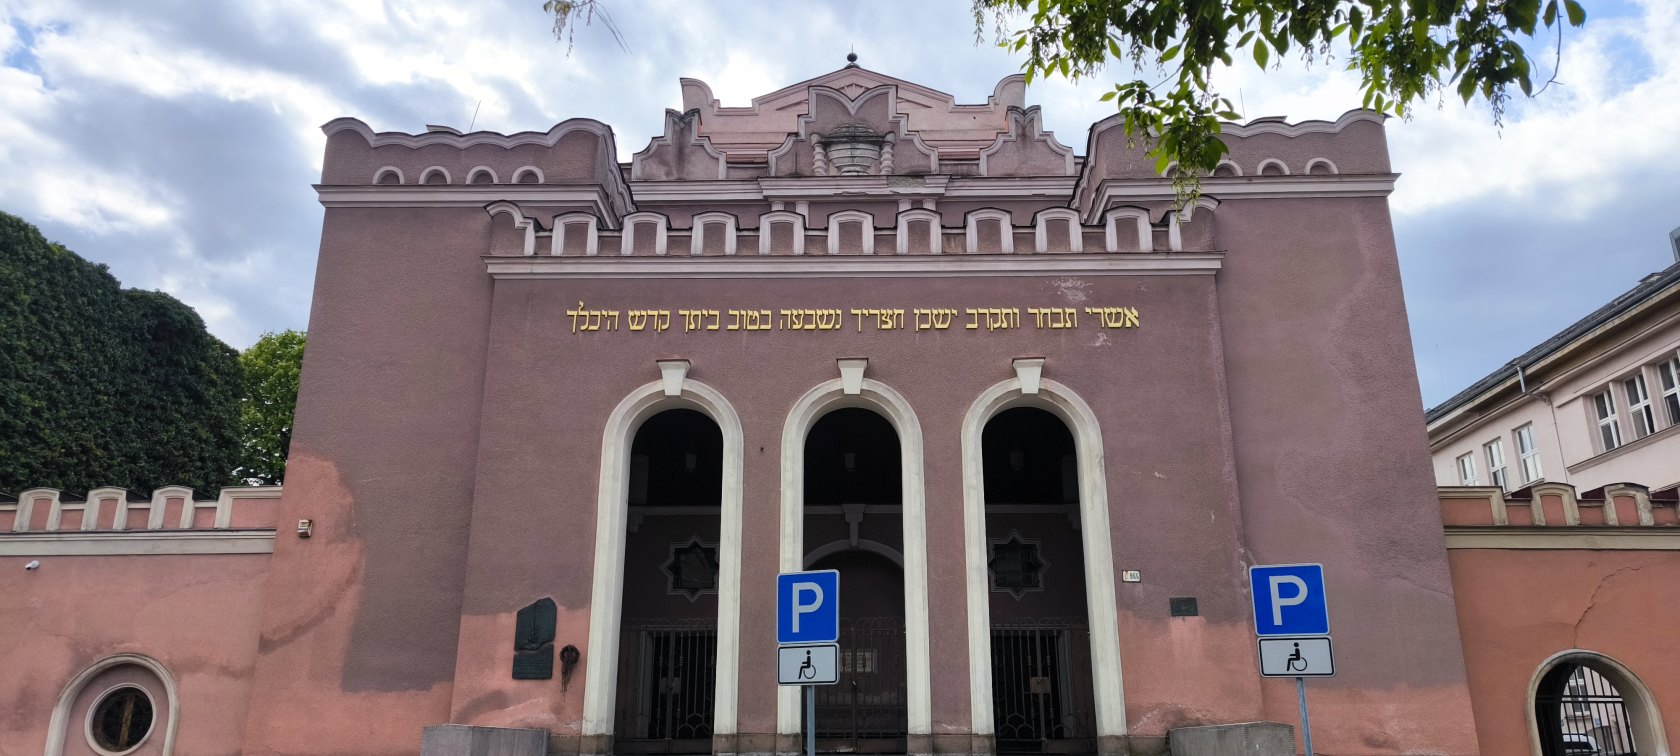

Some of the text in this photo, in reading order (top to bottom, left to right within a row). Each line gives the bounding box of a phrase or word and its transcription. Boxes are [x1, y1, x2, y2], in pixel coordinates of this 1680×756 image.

[566, 301, 1140, 333] אשרי תבחר ותקרב ישכן חצריך נשבעה בטוב ביתך קדש היכלך
[791, 581, 824, 634] P
[1268, 575, 1309, 626] P
